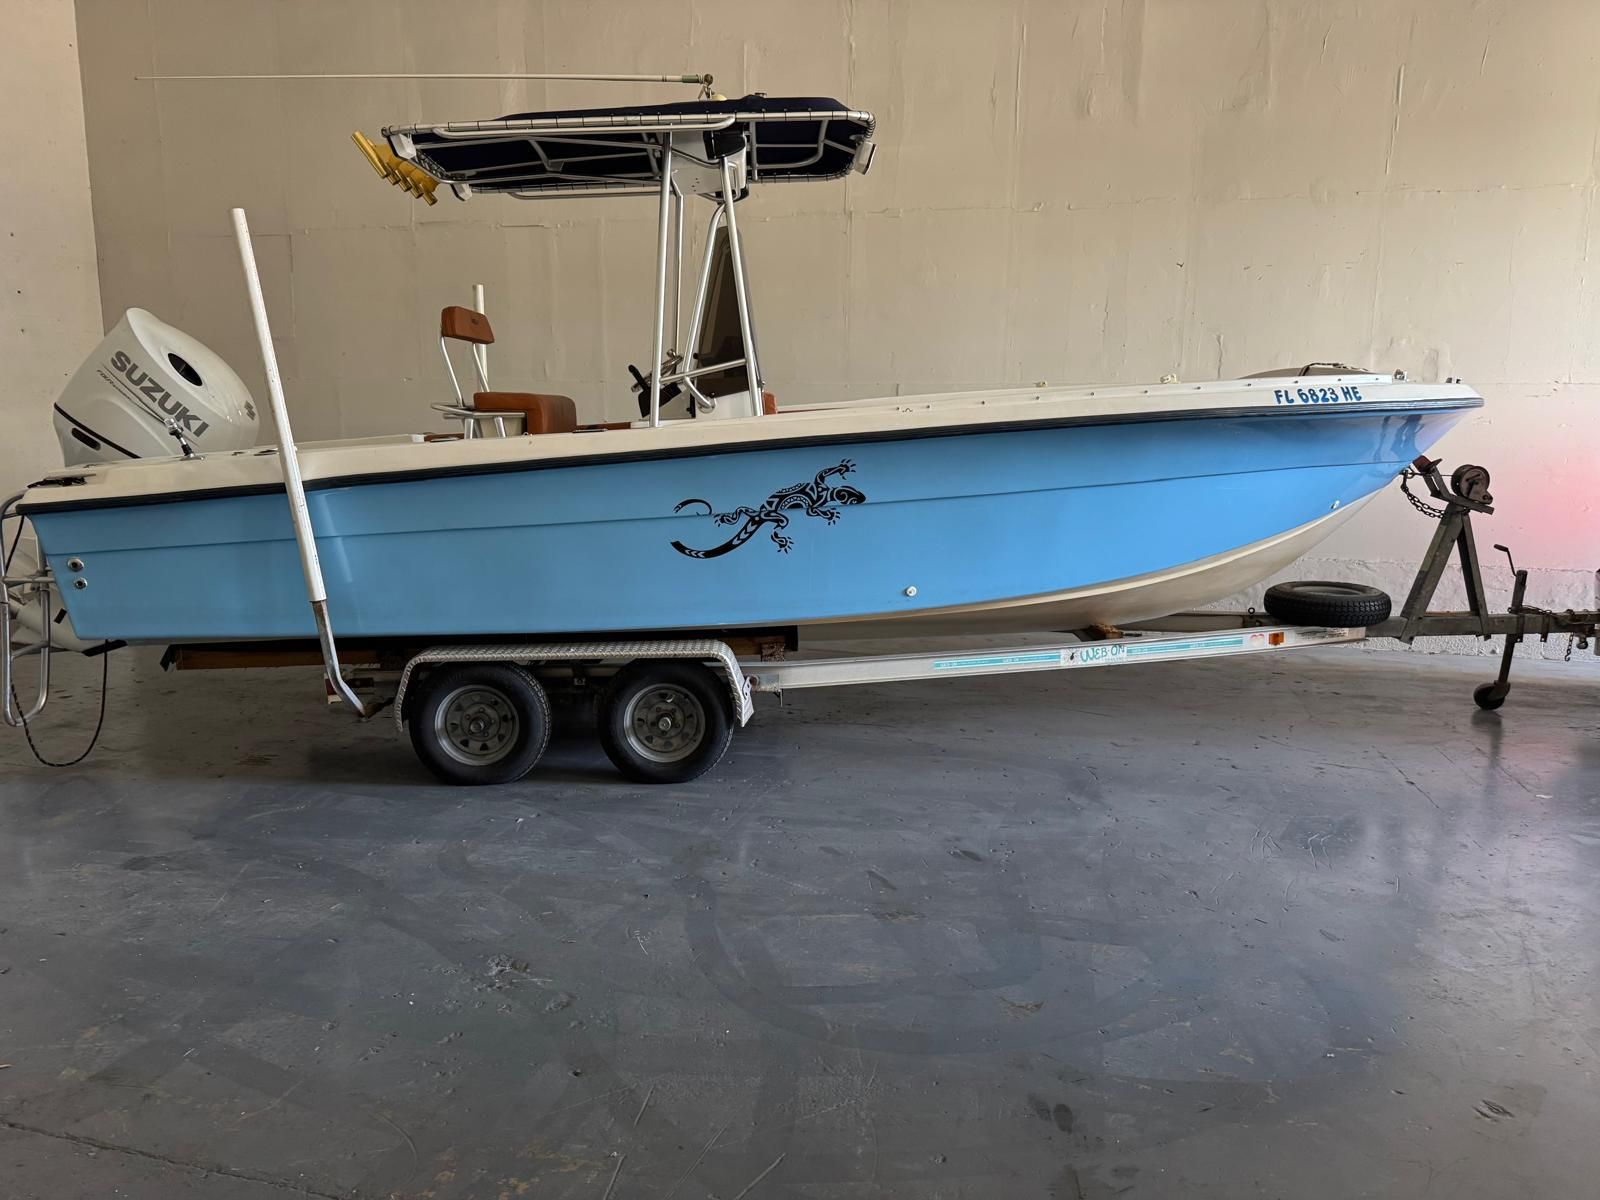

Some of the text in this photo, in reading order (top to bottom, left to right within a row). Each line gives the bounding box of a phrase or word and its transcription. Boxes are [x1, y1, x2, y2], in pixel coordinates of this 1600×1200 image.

[111, 351, 209, 437] SUZUKI
[1274, 386, 1362, 404] FL 6823 HE
